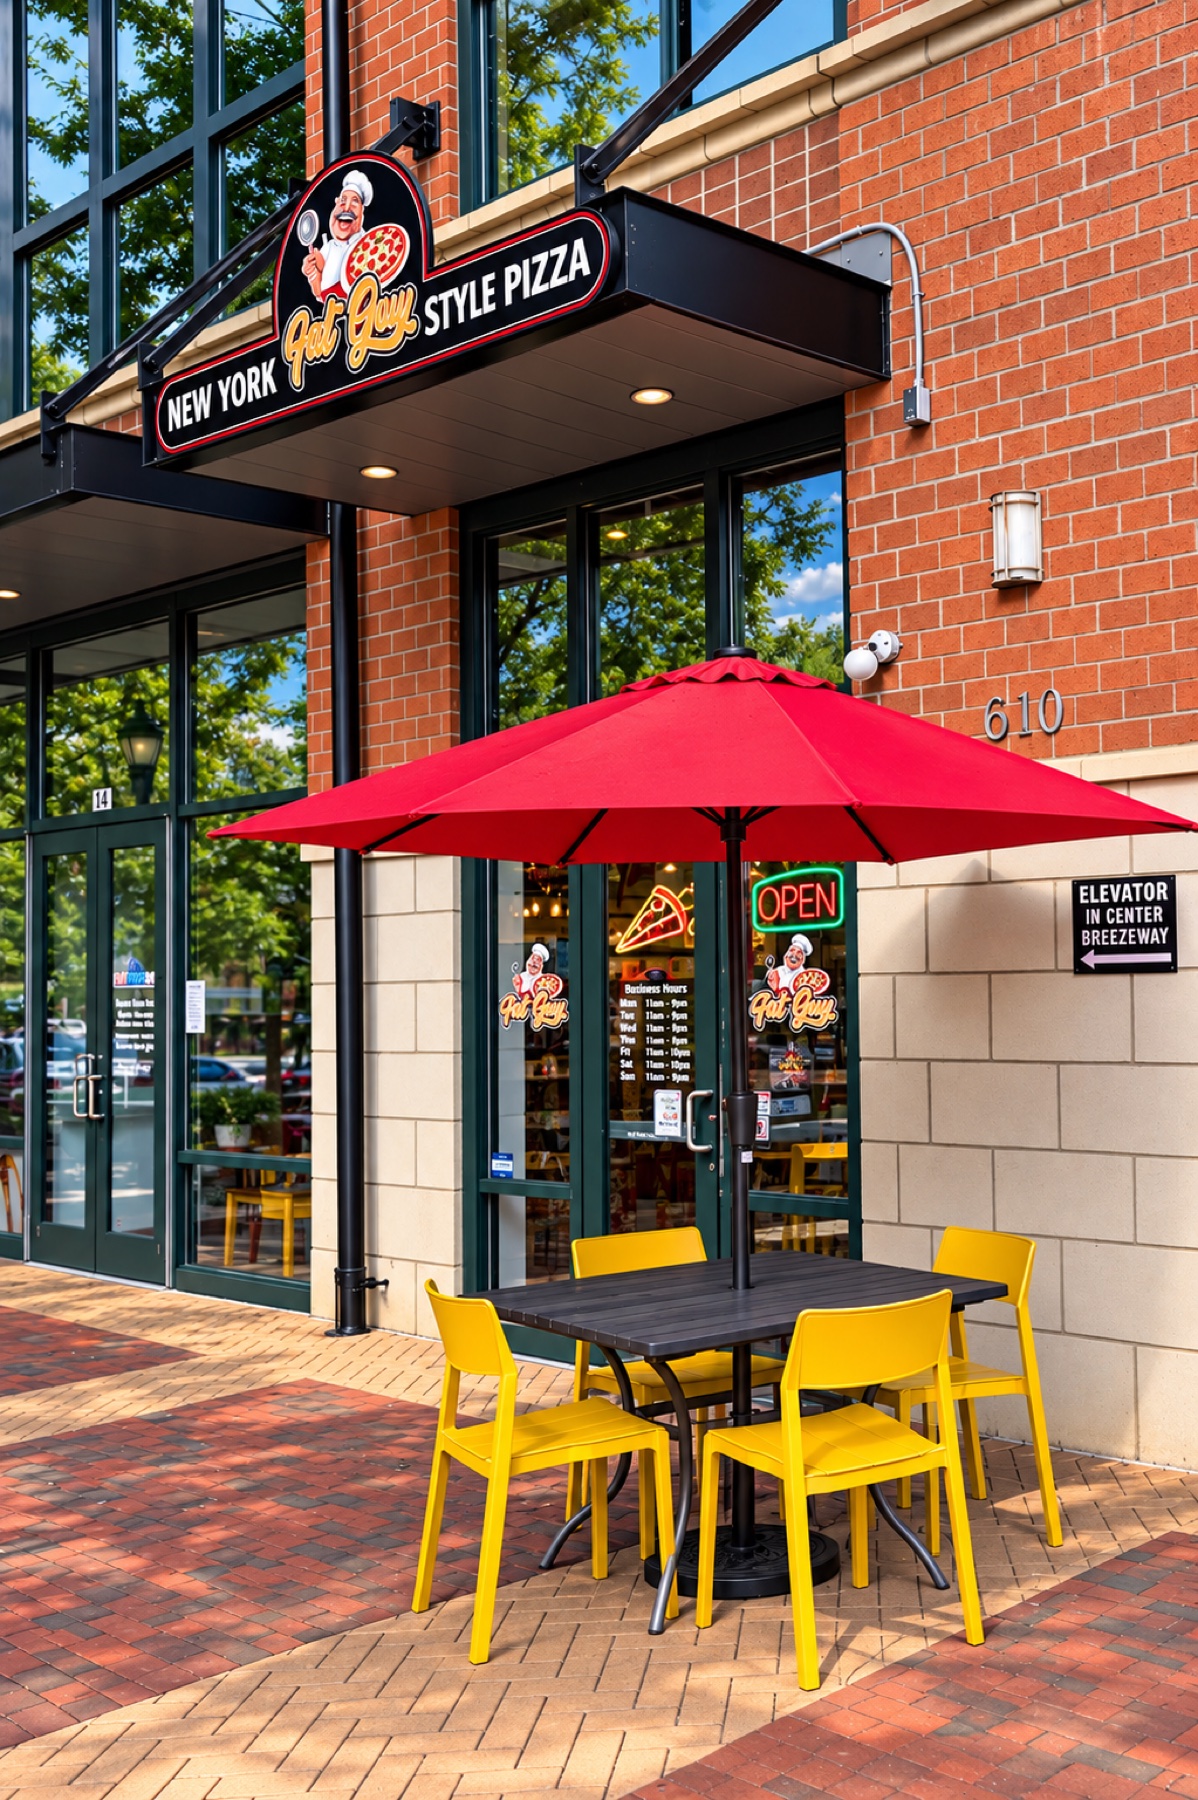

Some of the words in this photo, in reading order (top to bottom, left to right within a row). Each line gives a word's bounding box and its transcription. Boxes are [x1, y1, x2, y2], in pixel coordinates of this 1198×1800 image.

[424, 271, 496, 336] STYLE
[503, 237, 592, 307] PIZZA
[284, 302, 344, 388] Fat
[167, 382, 213, 433] NEW
[217, 357, 278, 413] YORK
[983, 688, 1064, 741] 610
[94, 790, 109, 811] 14
[757, 881, 836, 921] OPEN
[1079, 881, 1169, 904] ELEVATOR
[1086, 908, 1101, 925] IN
[1106, 905, 1164, 925] CENTER
[1081, 926, 1169, 947] BREEZEWAY
